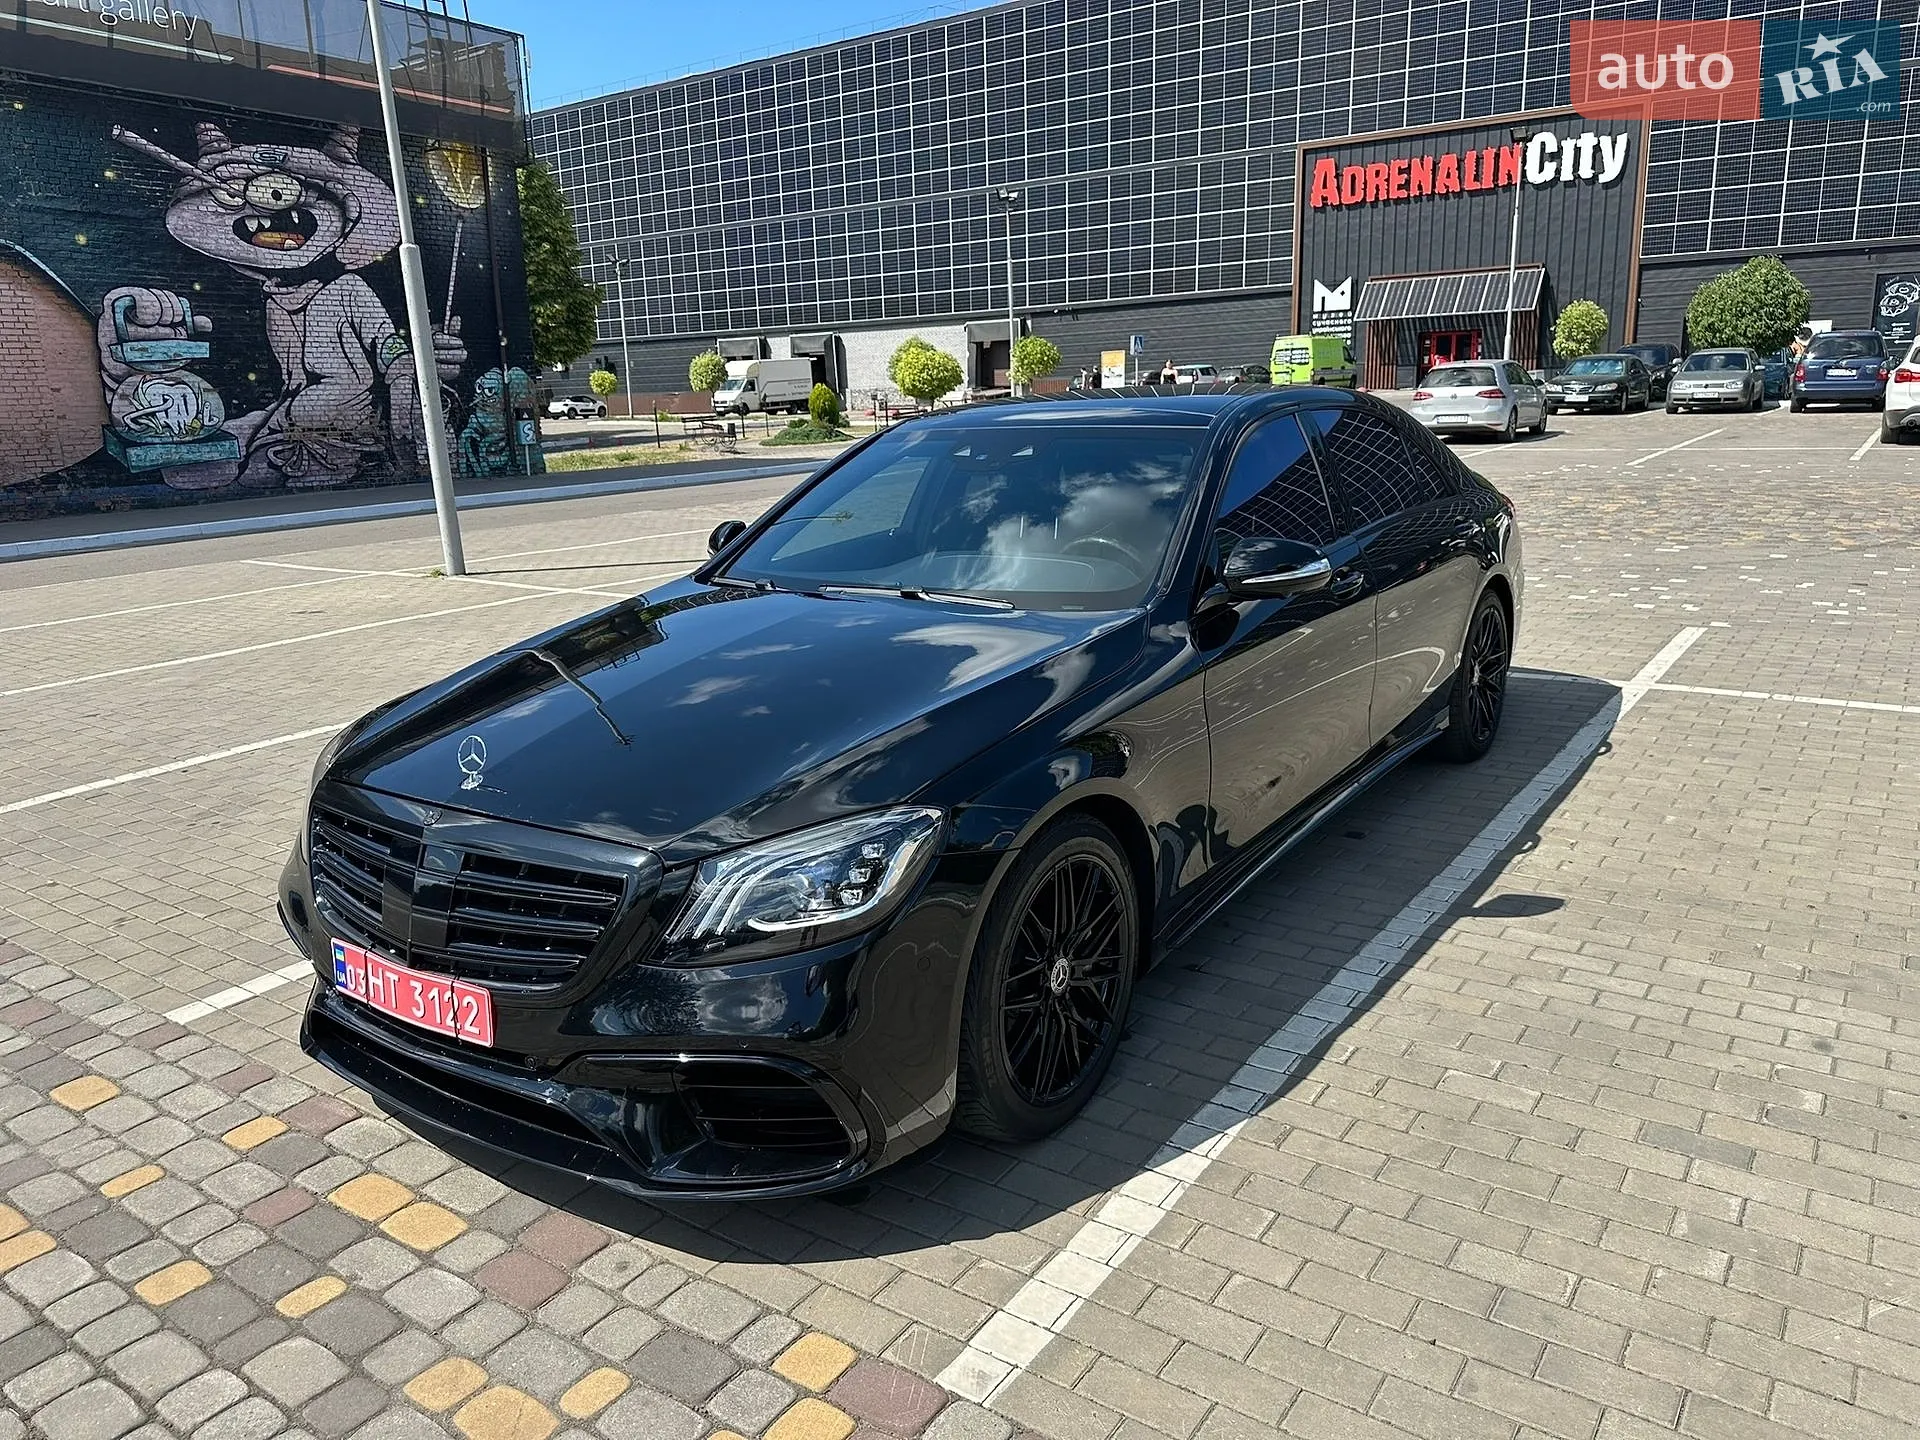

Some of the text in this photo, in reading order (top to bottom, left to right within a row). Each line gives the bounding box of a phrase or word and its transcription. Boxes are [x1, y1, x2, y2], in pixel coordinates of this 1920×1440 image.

[100, 0, 197, 41] gallery
[336, 970, 347, 985] UA
[409, 980, 481, 1035] 3122
